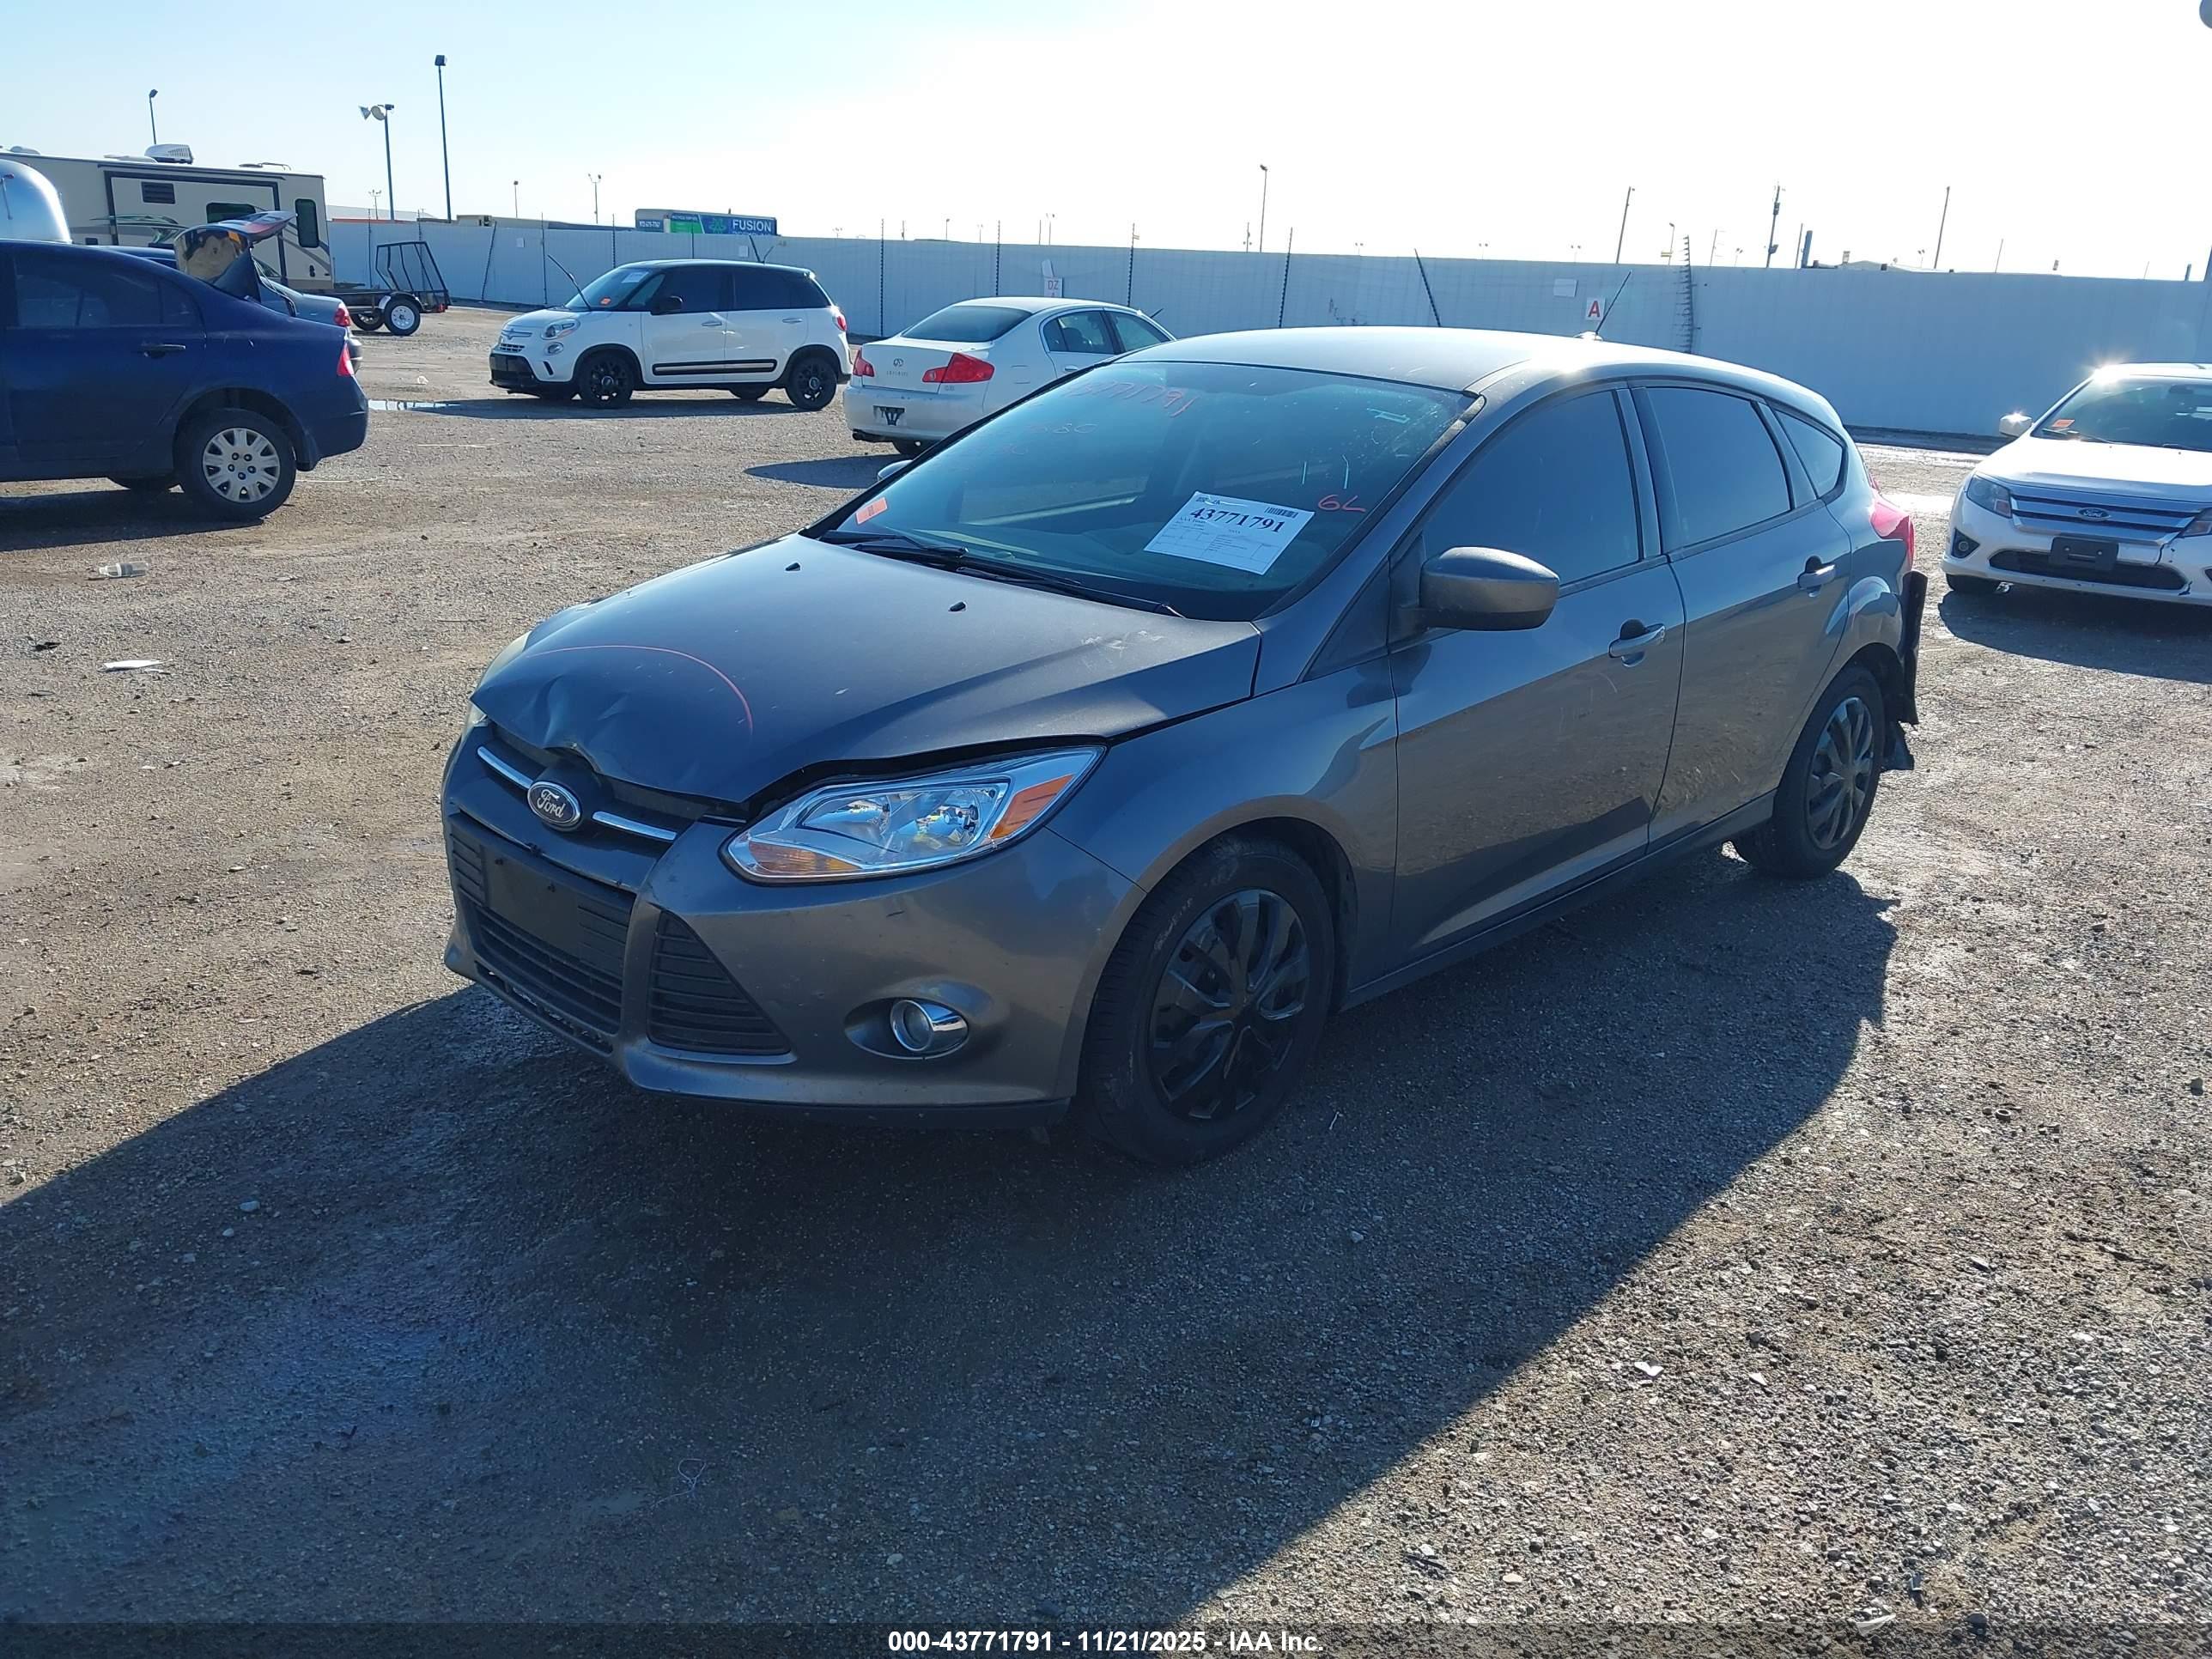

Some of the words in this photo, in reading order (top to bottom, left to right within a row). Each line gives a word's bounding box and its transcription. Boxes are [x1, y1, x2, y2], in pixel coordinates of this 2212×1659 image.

[732, 219, 772, 232] FUSION
[1588, 301, 1601, 318] A
[1190, 507, 1285, 533] 43771791
[537, 789, 566, 817] Ford
